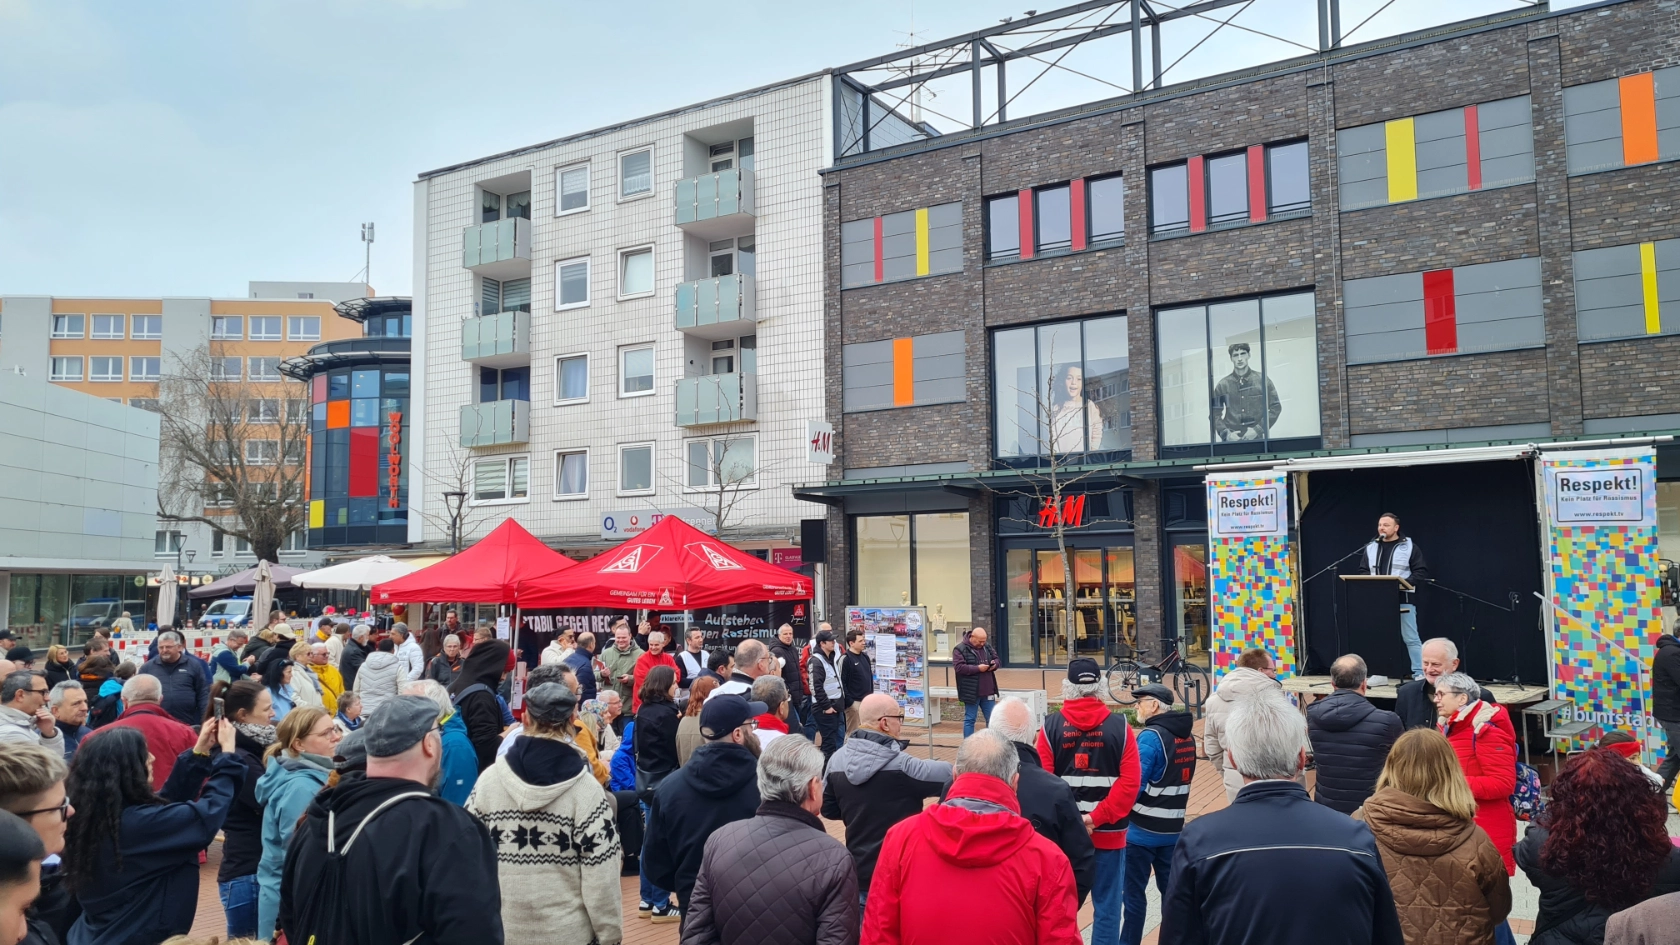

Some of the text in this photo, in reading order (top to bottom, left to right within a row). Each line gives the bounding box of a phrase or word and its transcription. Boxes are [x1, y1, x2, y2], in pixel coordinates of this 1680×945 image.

[811, 431, 831, 454] H&M
[388, 411, 402, 508] WOOLWORTH
[1560, 475, 1637, 493] Respekt!
[1220, 493, 1274, 510] Respekt!
[1038, 494, 1086, 528] H&M
[609, 589, 638, 597] GEMEINSAM
[704, 613, 764, 626] Aufstehen
[721, 626, 777, 639] Rassismu
[1563, 706, 1662, 728] #buntstad
[1062, 741, 1076, 749] und
